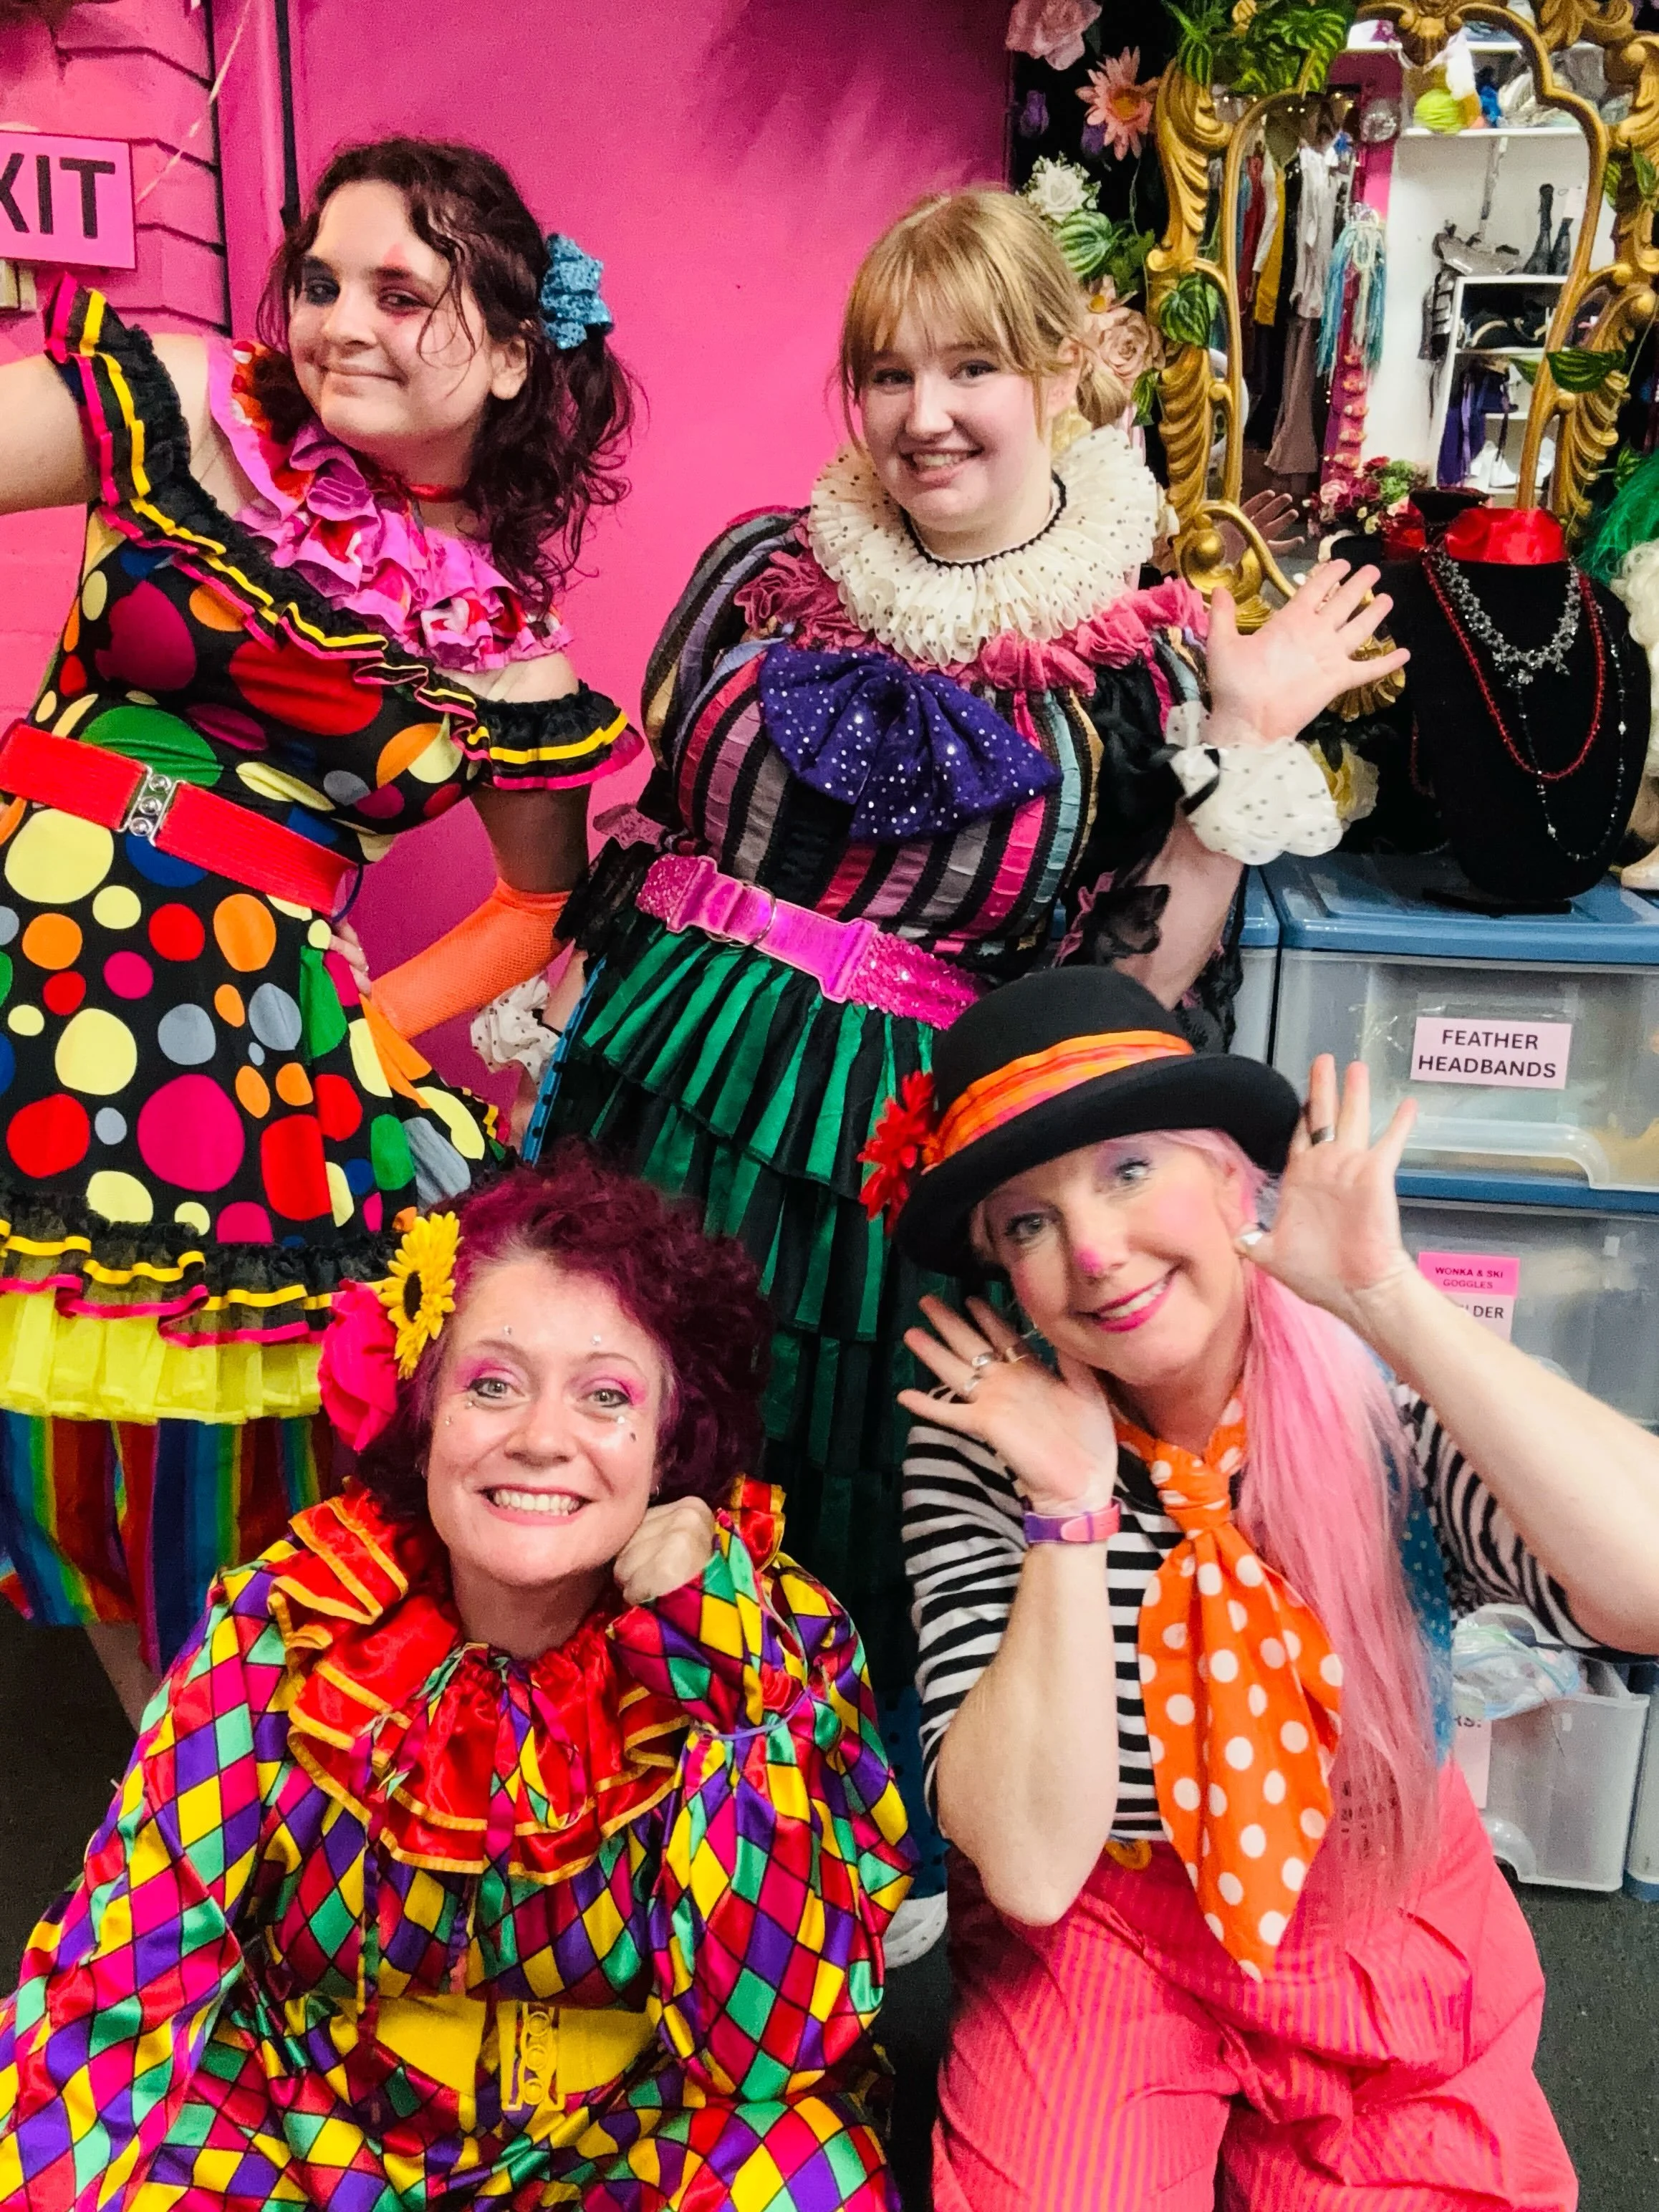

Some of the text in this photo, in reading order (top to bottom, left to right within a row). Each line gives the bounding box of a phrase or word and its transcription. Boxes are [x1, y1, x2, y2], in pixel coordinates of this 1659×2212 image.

[1442, 1029, 1539, 1050] FEATHER
[1418, 1054, 1557, 1079] HEADBANDS
[1435, 1266, 1473, 1276] WONKA
[1486, 1270, 1504, 1279] SKI
[1443, 1279, 1494, 1289] GOGGLES
[1466, 1304, 1504, 1319] DER
